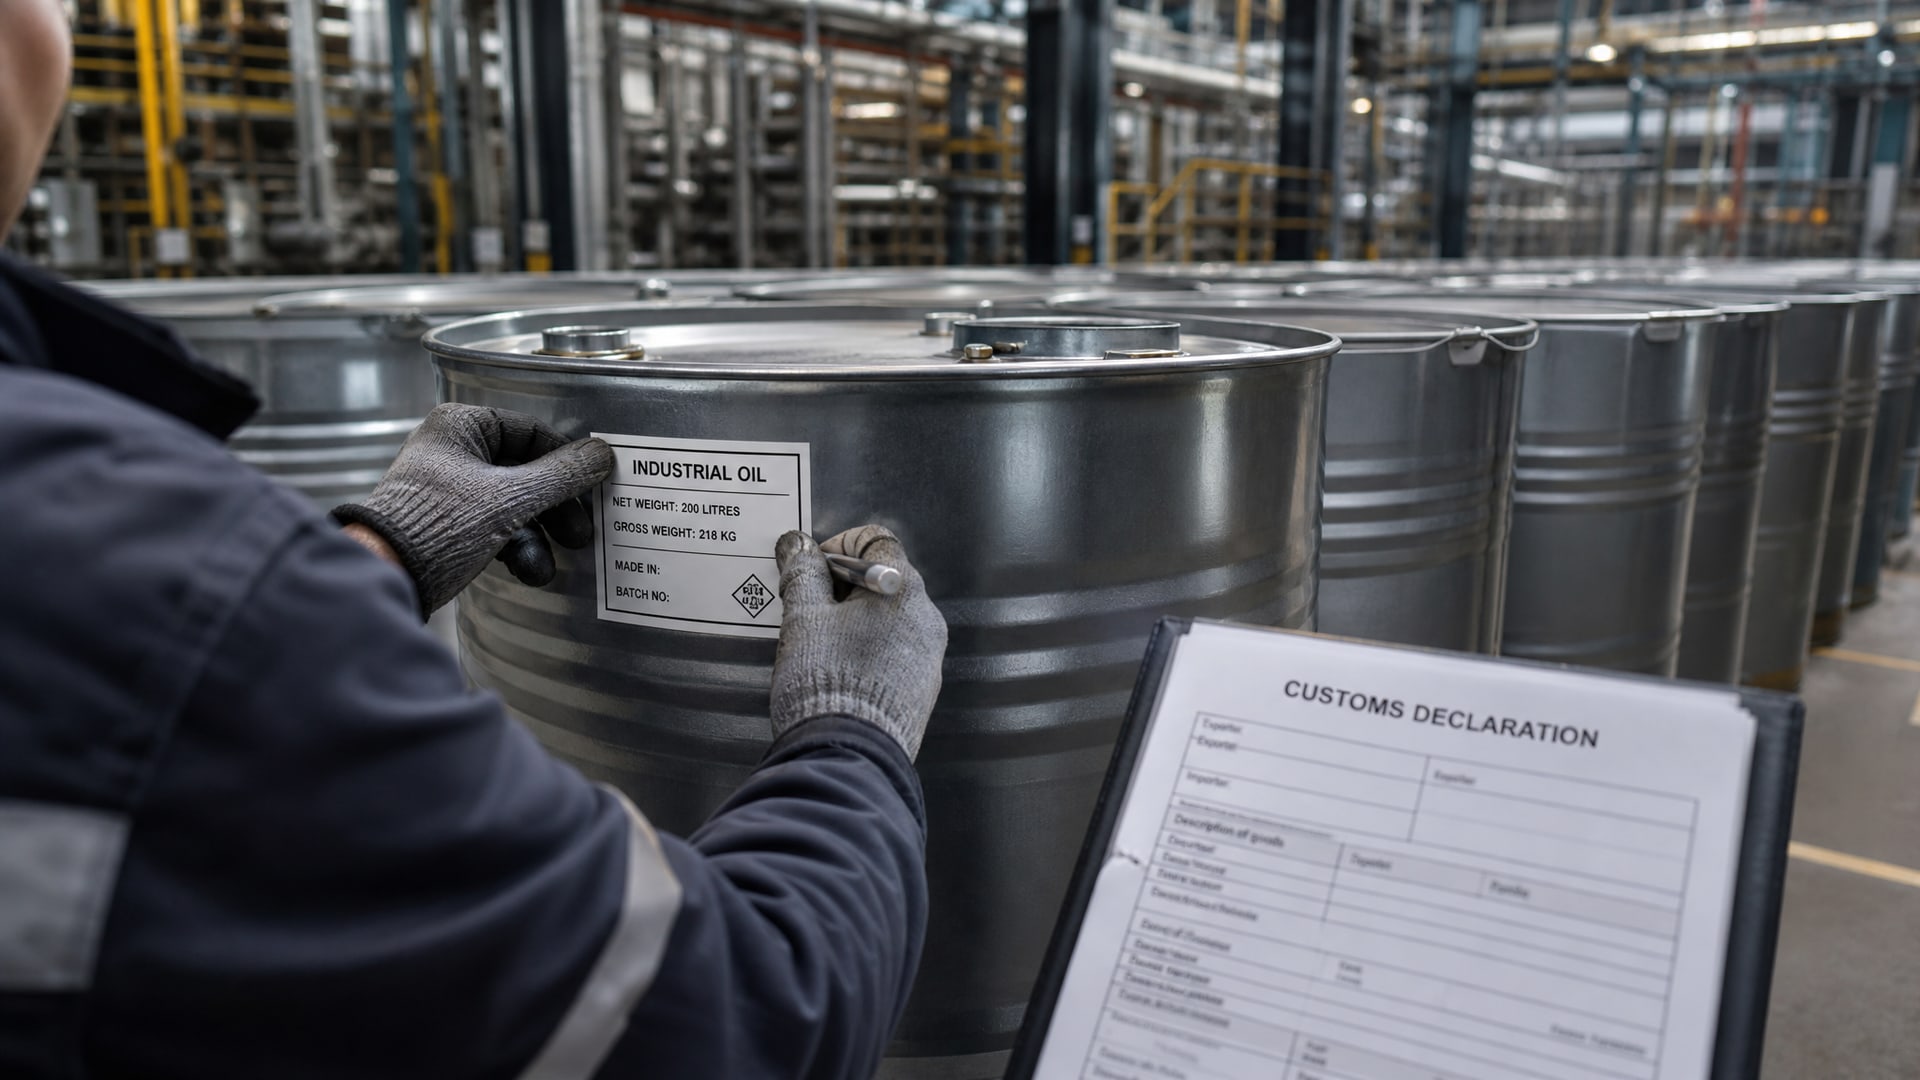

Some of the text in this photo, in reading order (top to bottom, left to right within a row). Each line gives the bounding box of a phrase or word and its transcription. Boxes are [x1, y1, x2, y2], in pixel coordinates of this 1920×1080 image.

[633, 459, 767, 483] INDUSTRIAL OIL
[612, 496, 741, 517] NET WEIGHT: 200 LITRES
[613, 521, 737, 542] GROSS WEIGHT: 218 KG
[615, 560, 661, 575] MADE IN:
[616, 586, 670, 602] BATCH NO:
[1283, 680, 1600, 749] CUSTOMS DECLARATION
